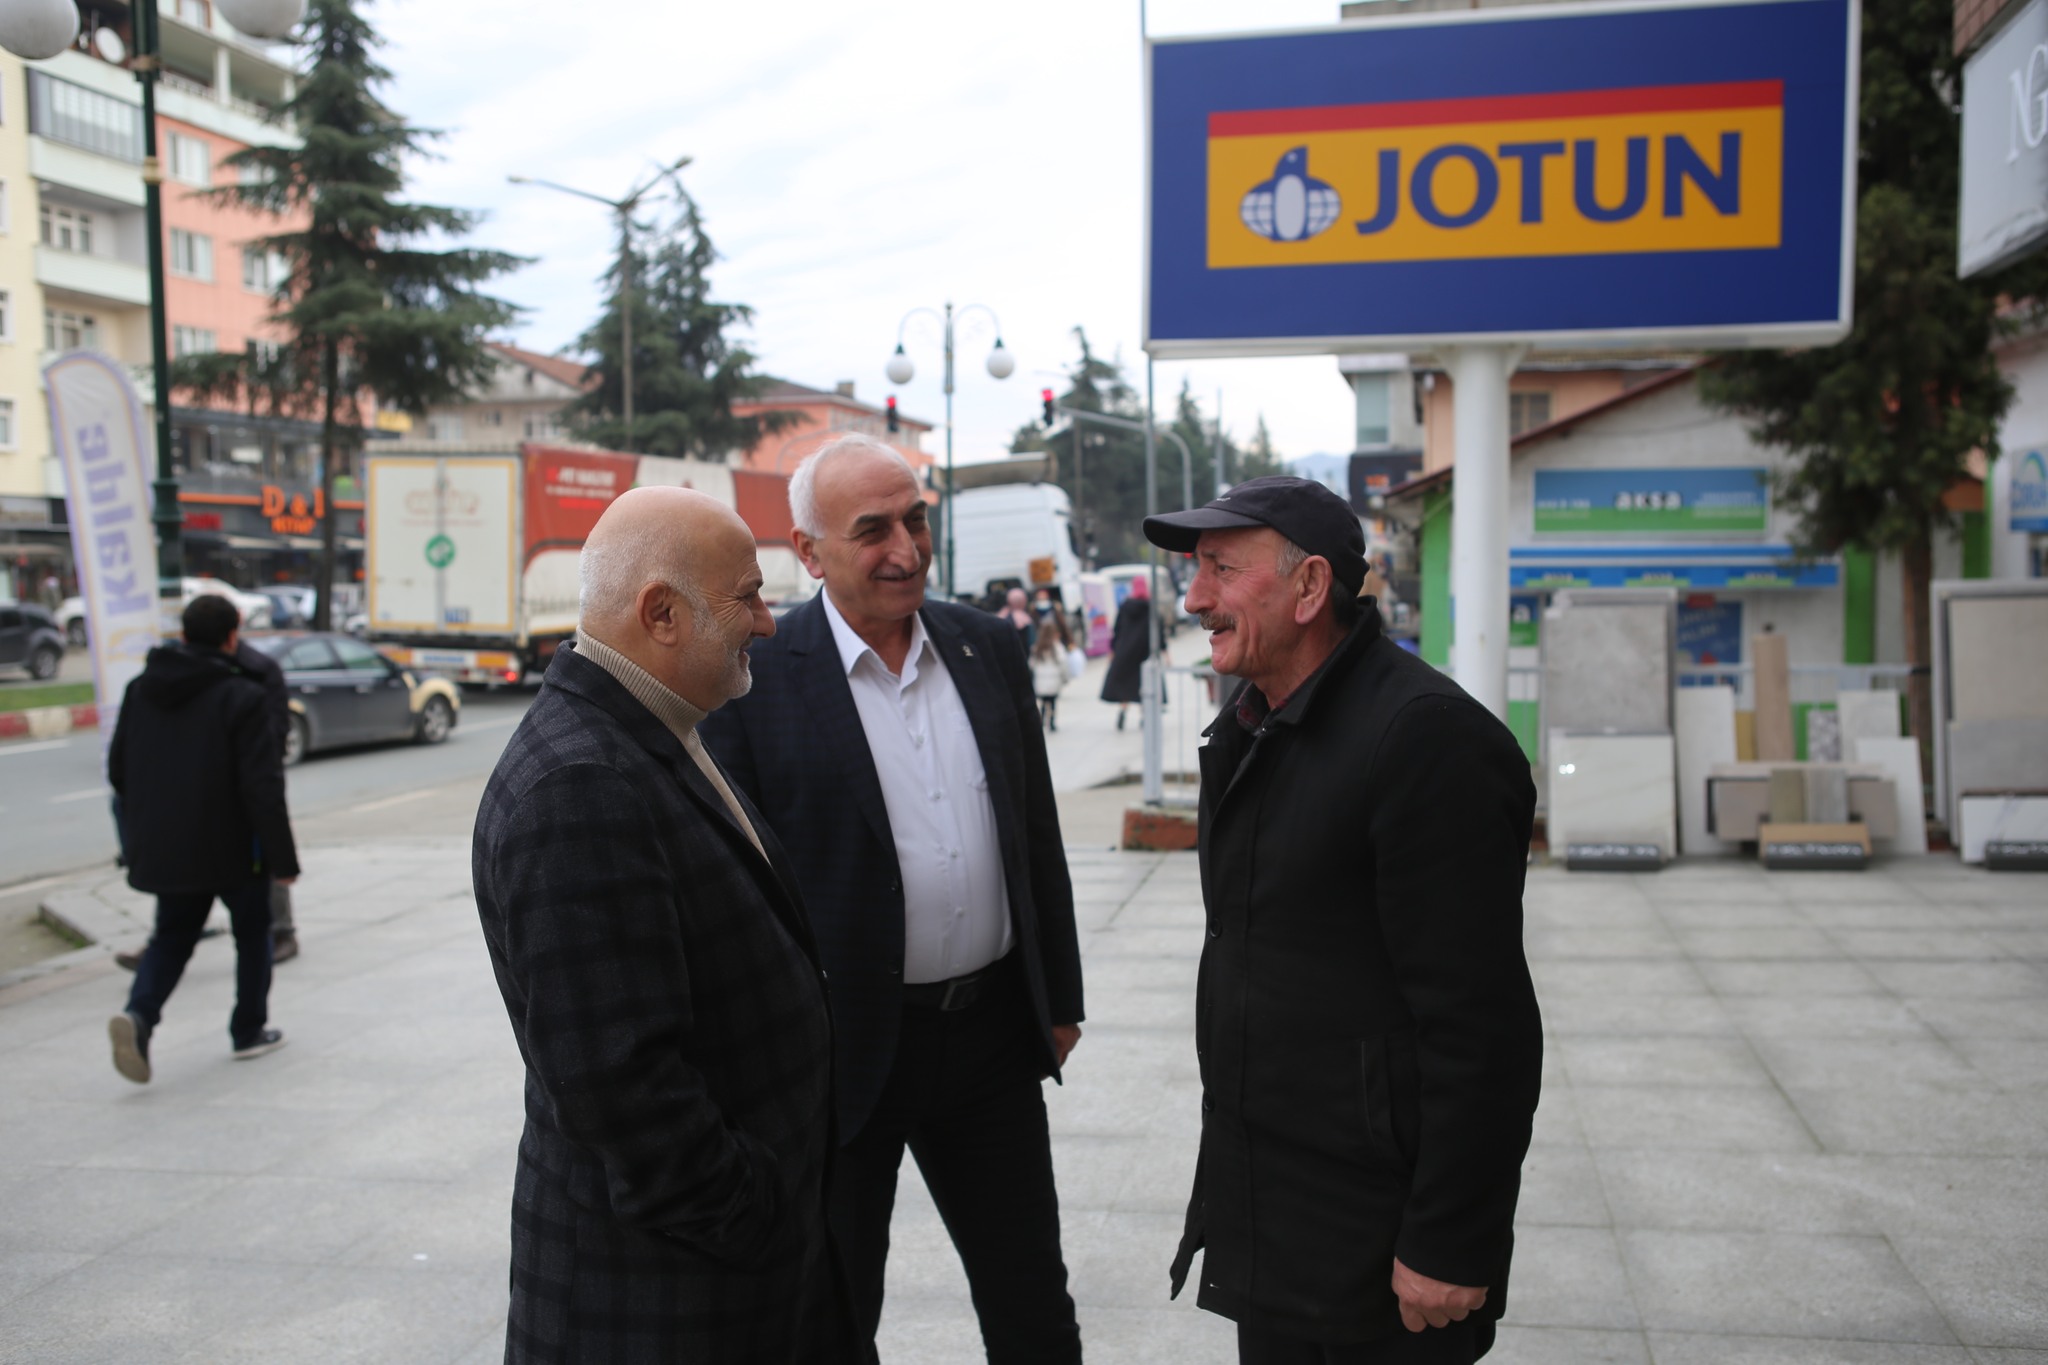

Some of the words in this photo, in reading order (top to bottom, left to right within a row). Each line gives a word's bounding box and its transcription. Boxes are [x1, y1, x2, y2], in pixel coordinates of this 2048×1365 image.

[1355, 131, 1742, 234] JOTUN
[261, 485, 285, 518] D
[1615, 490, 1682, 511] aksa
